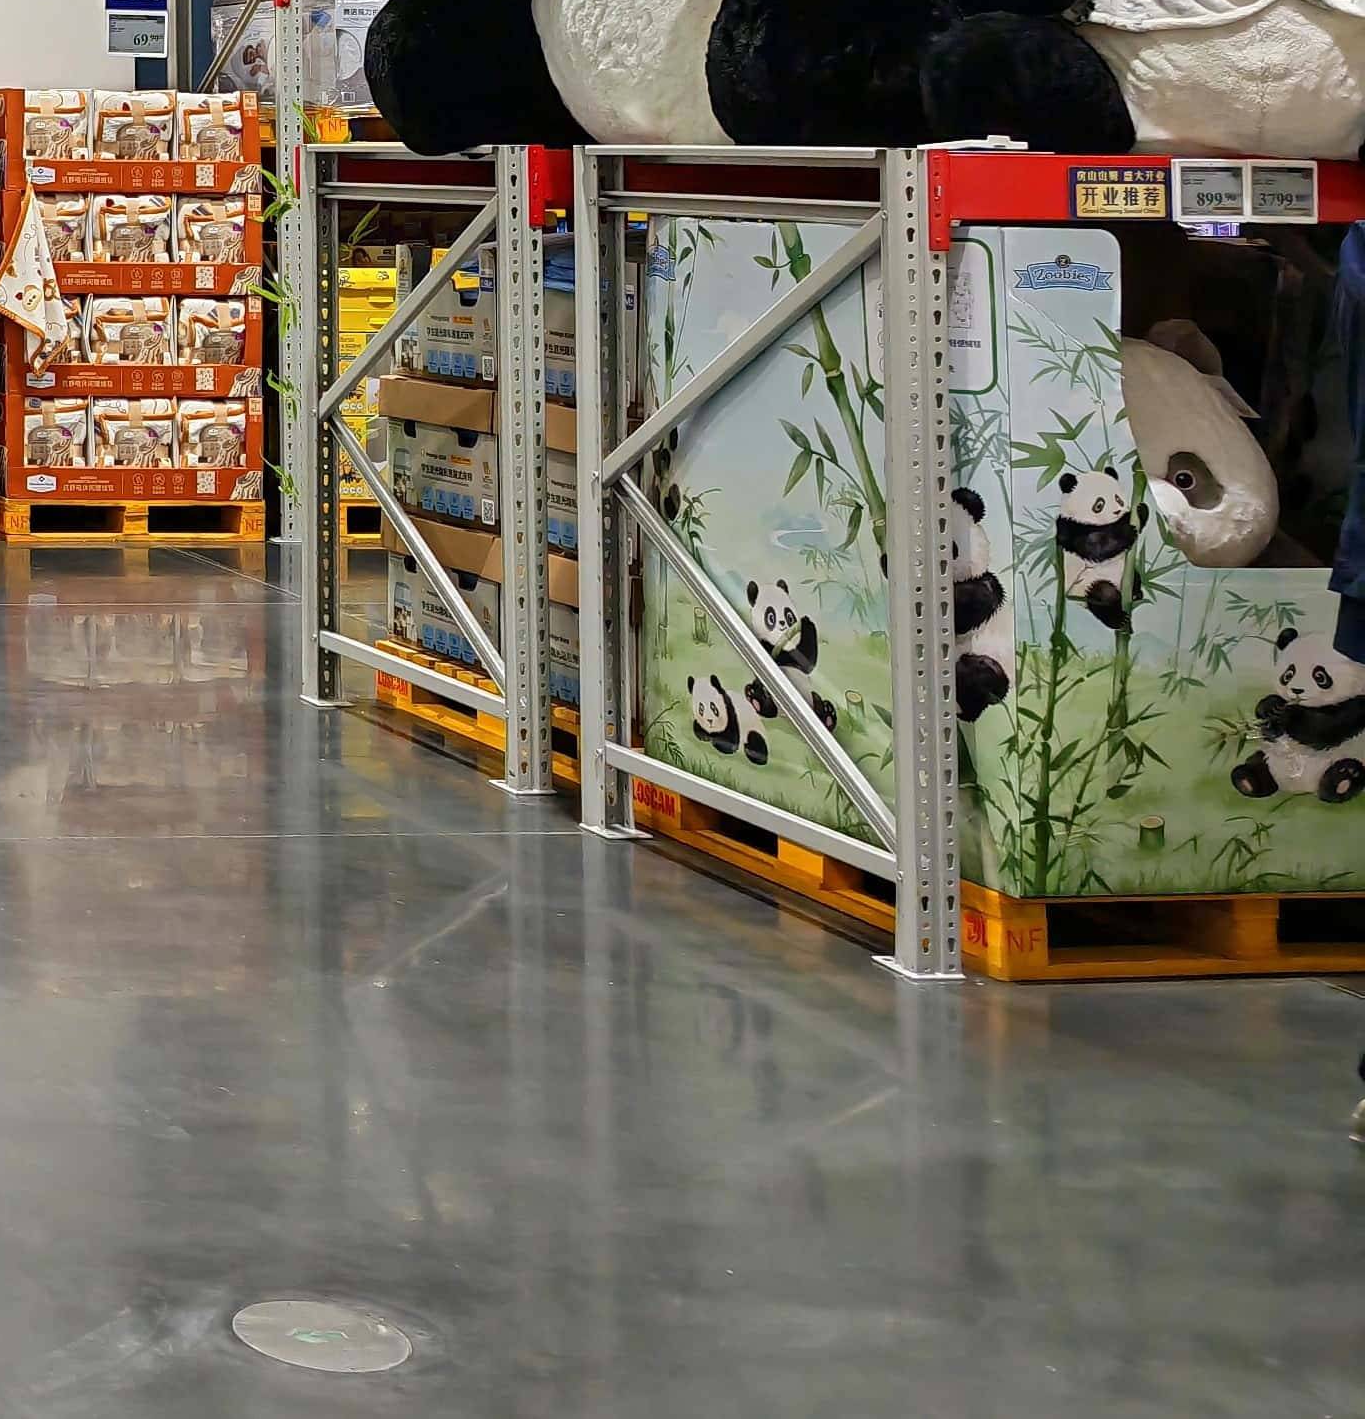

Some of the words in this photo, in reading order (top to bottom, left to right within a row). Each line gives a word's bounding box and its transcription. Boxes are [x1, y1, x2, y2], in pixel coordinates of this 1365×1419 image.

[1081, 185, 1162, 207] 开业推荐
[1034, 267, 1092, 283] Zoobies
[1006, 928, 1045, 955] NF
